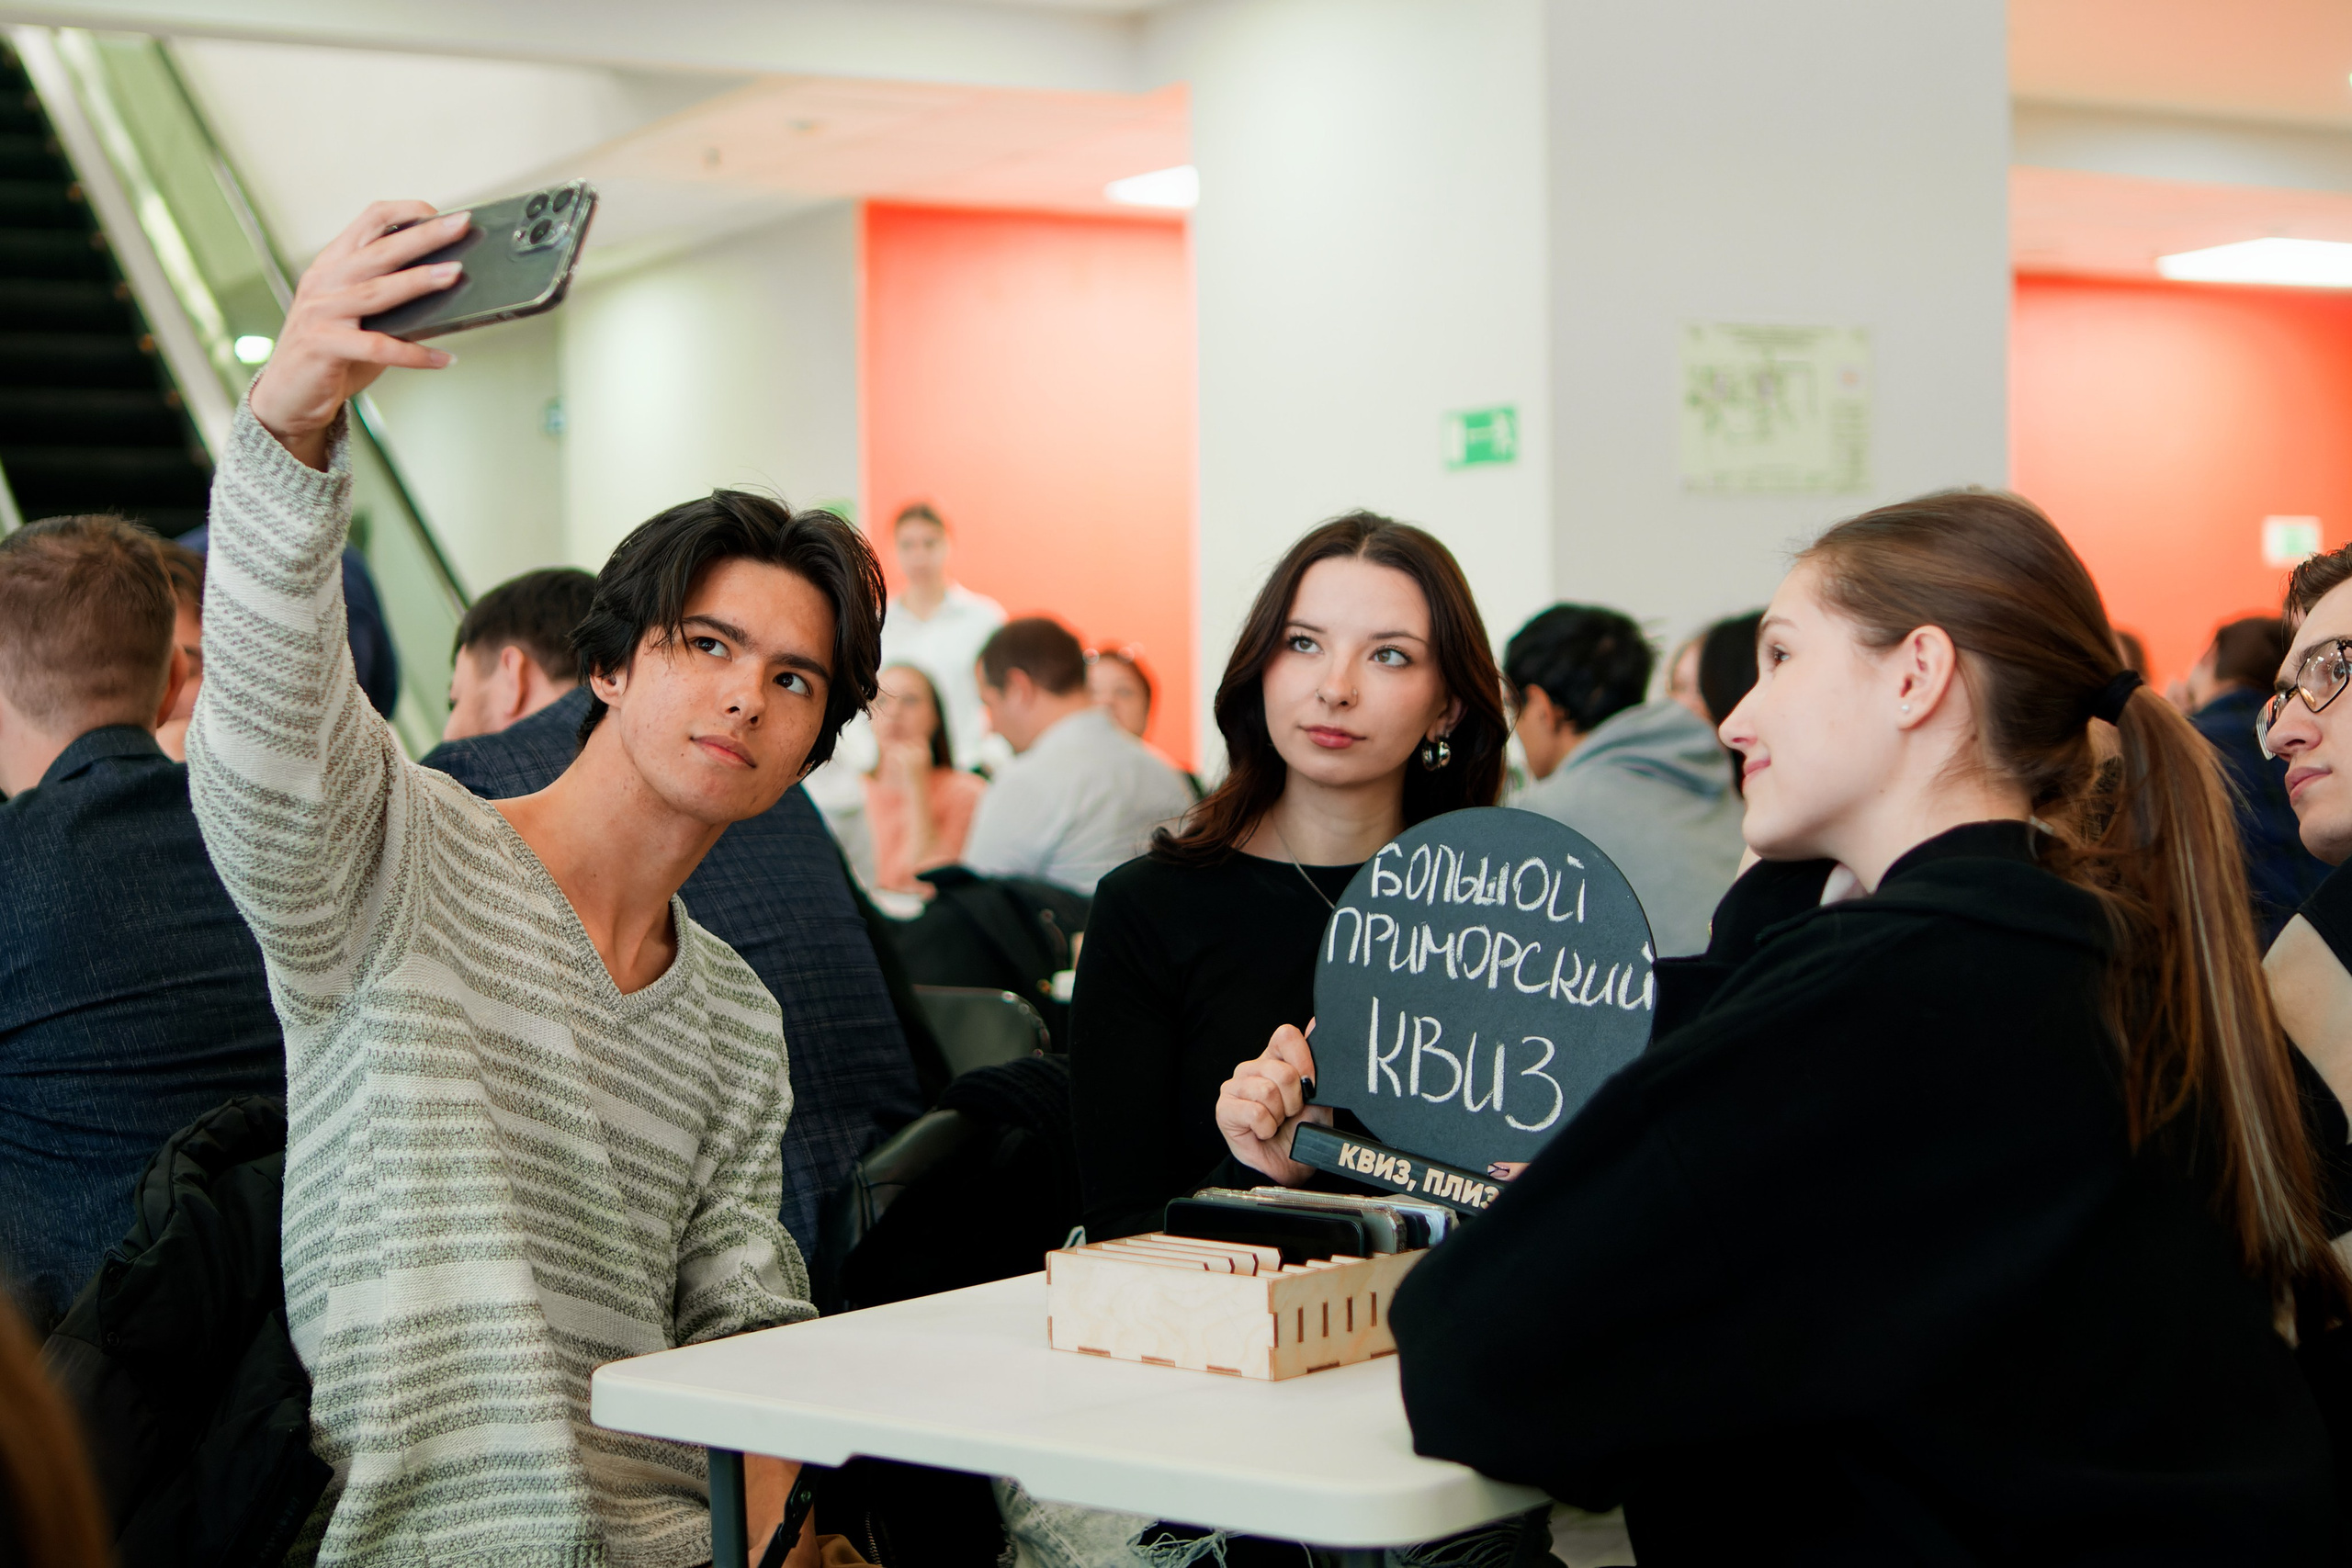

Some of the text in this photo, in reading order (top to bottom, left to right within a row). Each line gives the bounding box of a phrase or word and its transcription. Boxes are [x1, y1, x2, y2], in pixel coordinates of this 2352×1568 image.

[1371, 841, 1586, 923] БОЛЬШОЙ
[1327, 906, 1655, 1011] ПРИМОРСКИЙ
[1367, 996, 1564, 1133] КВИЗ
[1338, 1142, 1417, 1192] КВИЗ,
